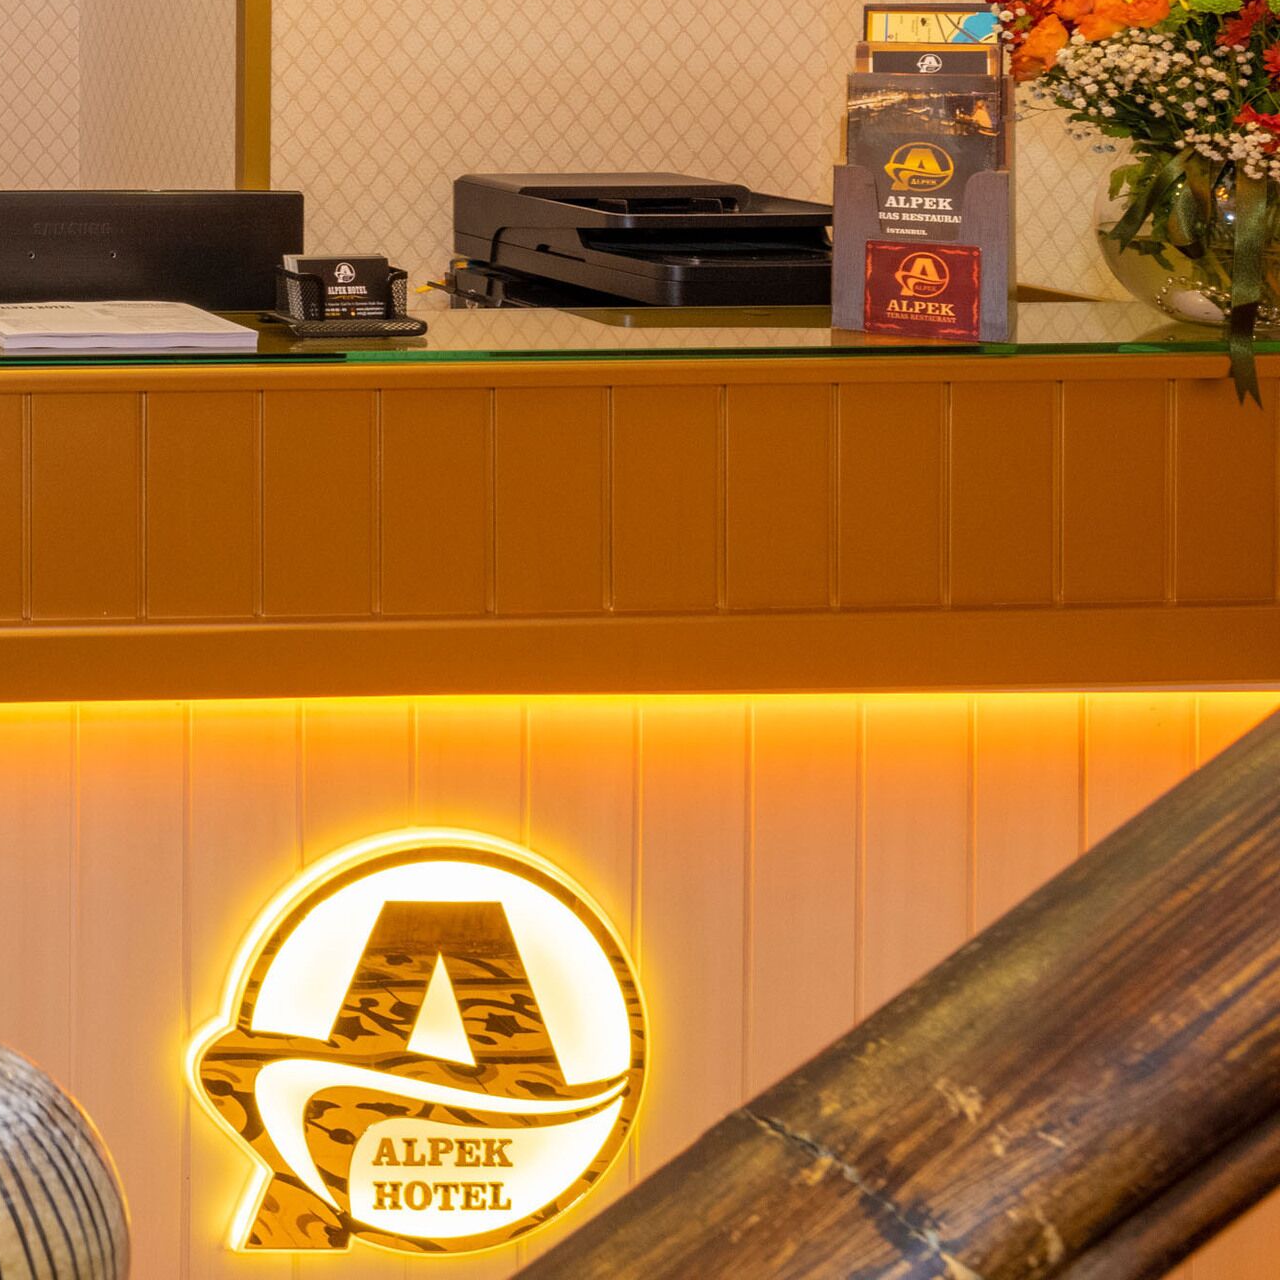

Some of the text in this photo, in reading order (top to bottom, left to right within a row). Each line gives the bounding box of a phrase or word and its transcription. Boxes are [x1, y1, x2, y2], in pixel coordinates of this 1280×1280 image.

[885, 196, 952, 210] ALPEK
[887, 300, 956, 316] ALPEK
[371, 1137, 513, 1167] ALPEK
[371, 1180, 512, 1211] HOTEL
